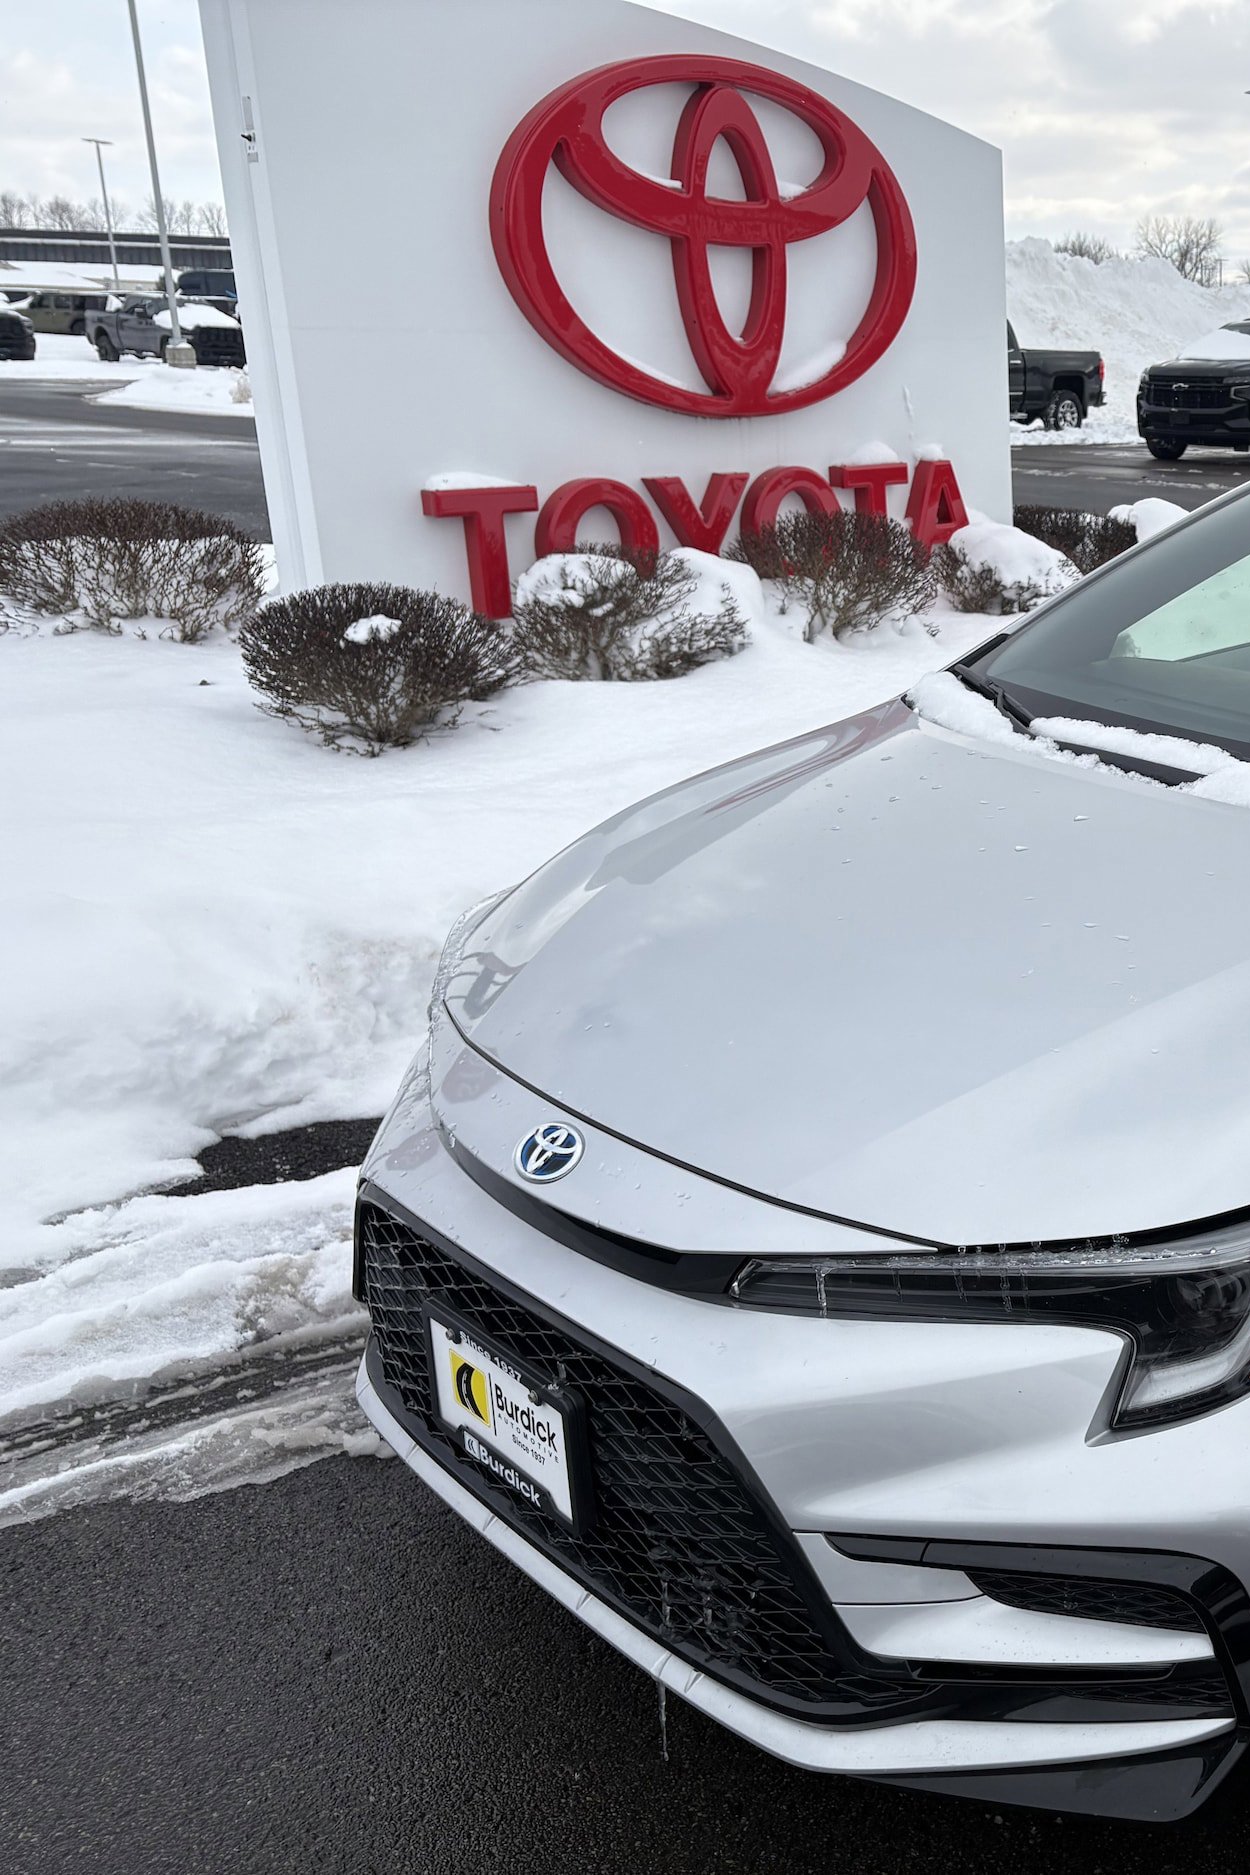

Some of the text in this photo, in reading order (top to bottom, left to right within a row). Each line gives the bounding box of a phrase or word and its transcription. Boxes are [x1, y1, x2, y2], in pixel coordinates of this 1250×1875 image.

[421, 460, 969, 619] TOYOTA
[459, 1330, 521, 1382] Since 1937
[494, 1383, 558, 1453] Burdick
[498, 1413, 559, 1463] AUTOMOTIVE
[478, 1444, 542, 1507] Burdick
[512, 1434, 545, 1465] Since 1937
